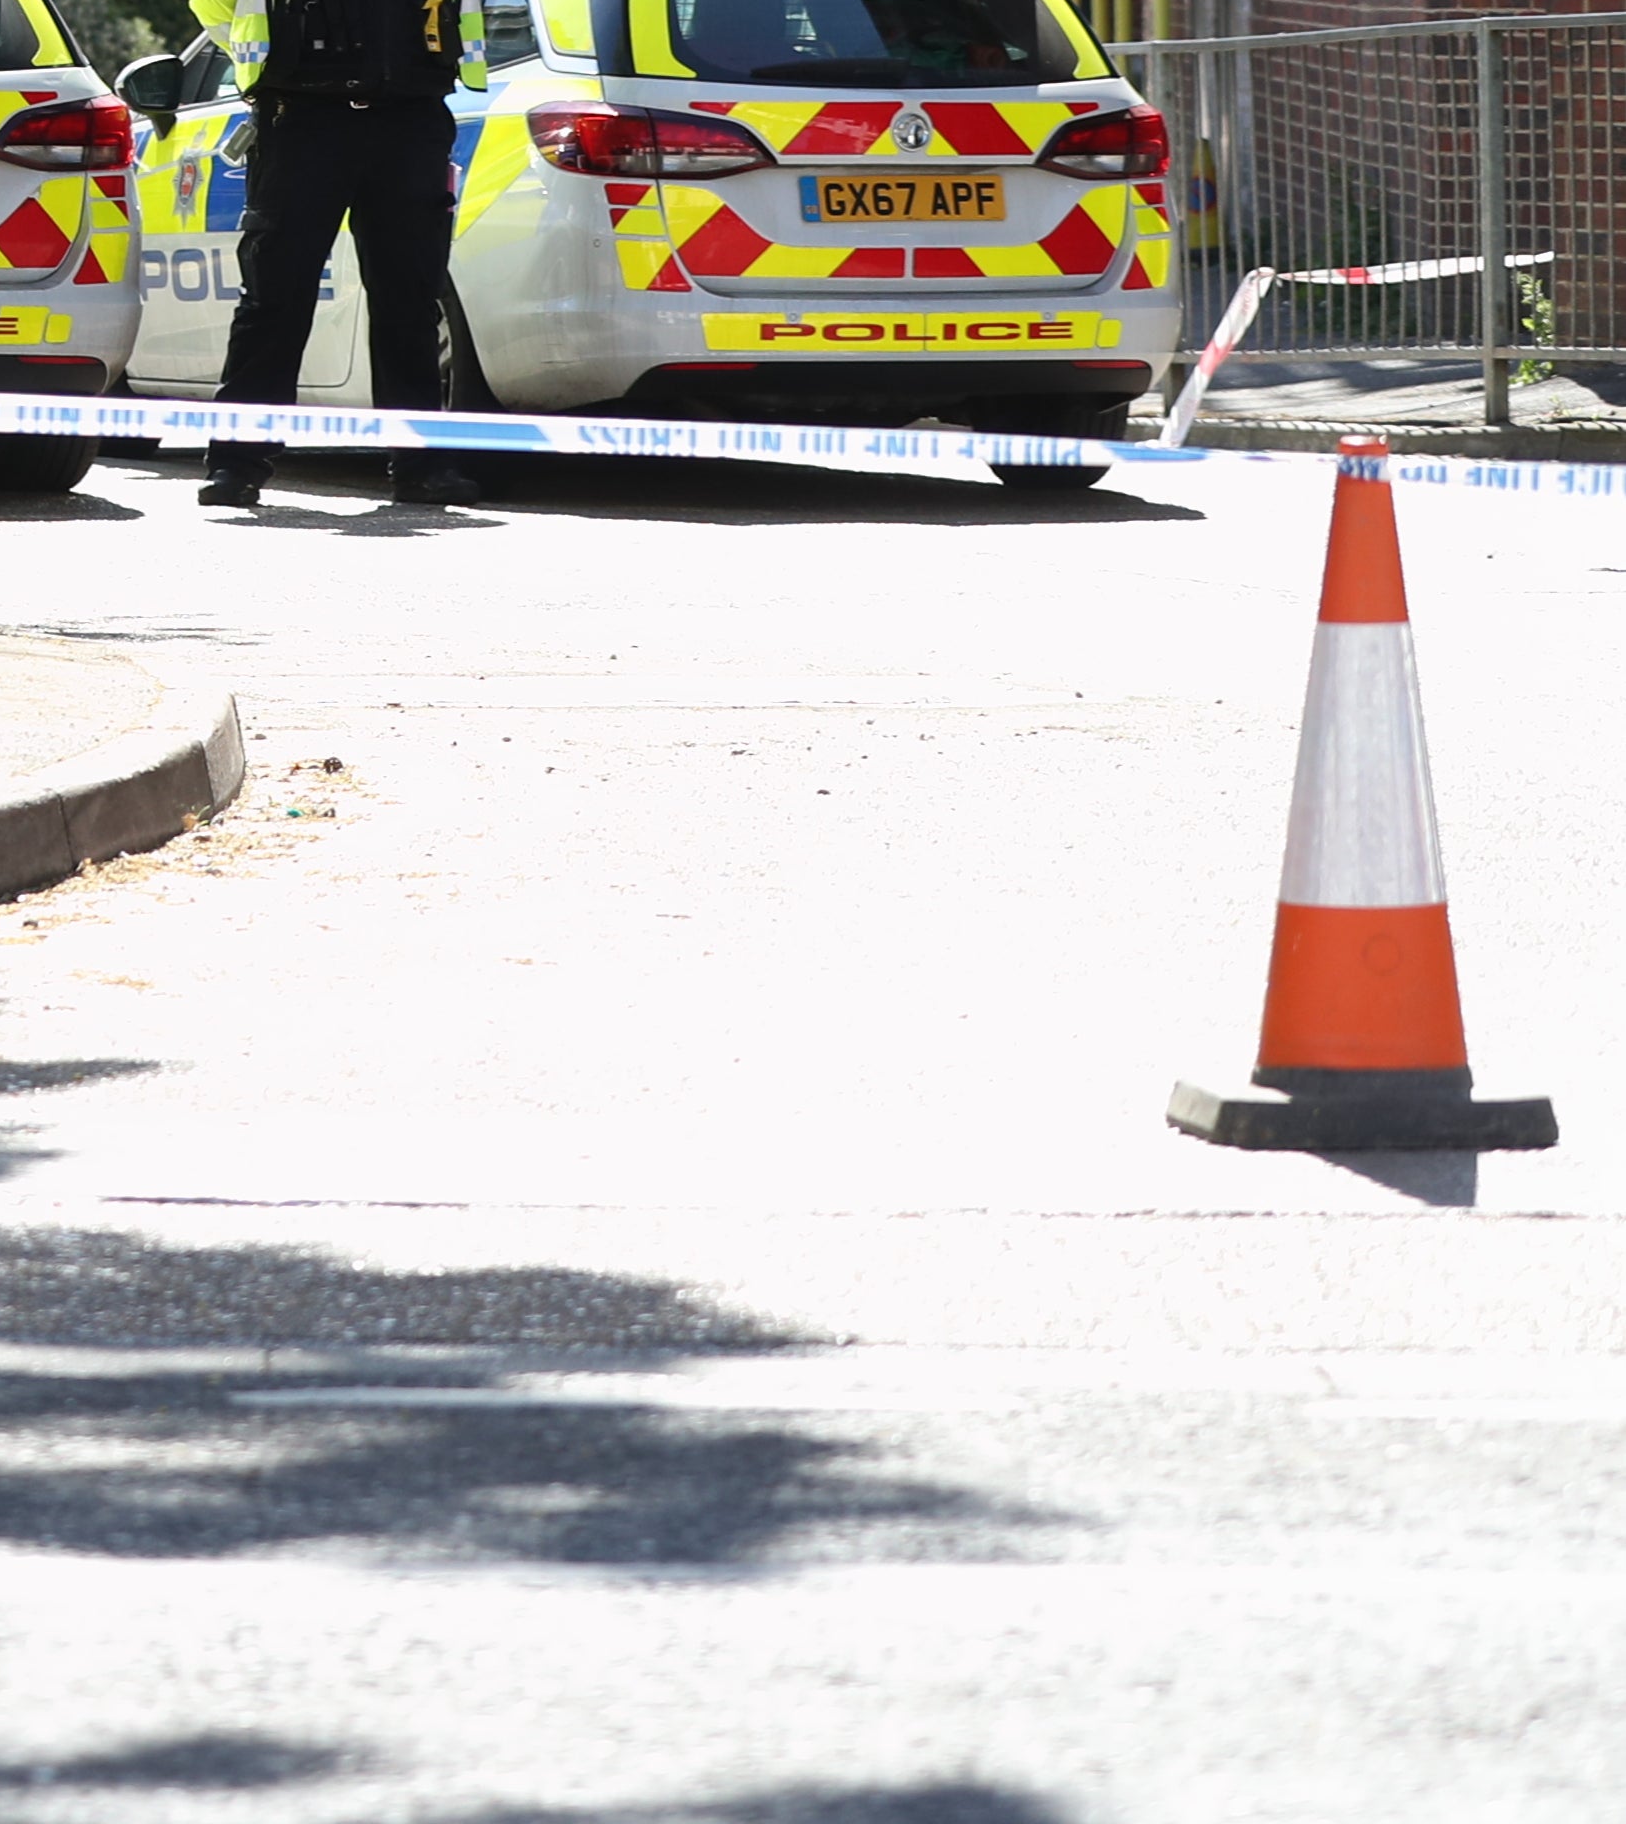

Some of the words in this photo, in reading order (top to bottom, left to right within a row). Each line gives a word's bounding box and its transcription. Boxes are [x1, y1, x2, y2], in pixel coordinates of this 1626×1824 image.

[824, 182, 916, 216] GX67
[931, 182, 996, 216] APF
[759, 321, 1076, 342] POLICE
